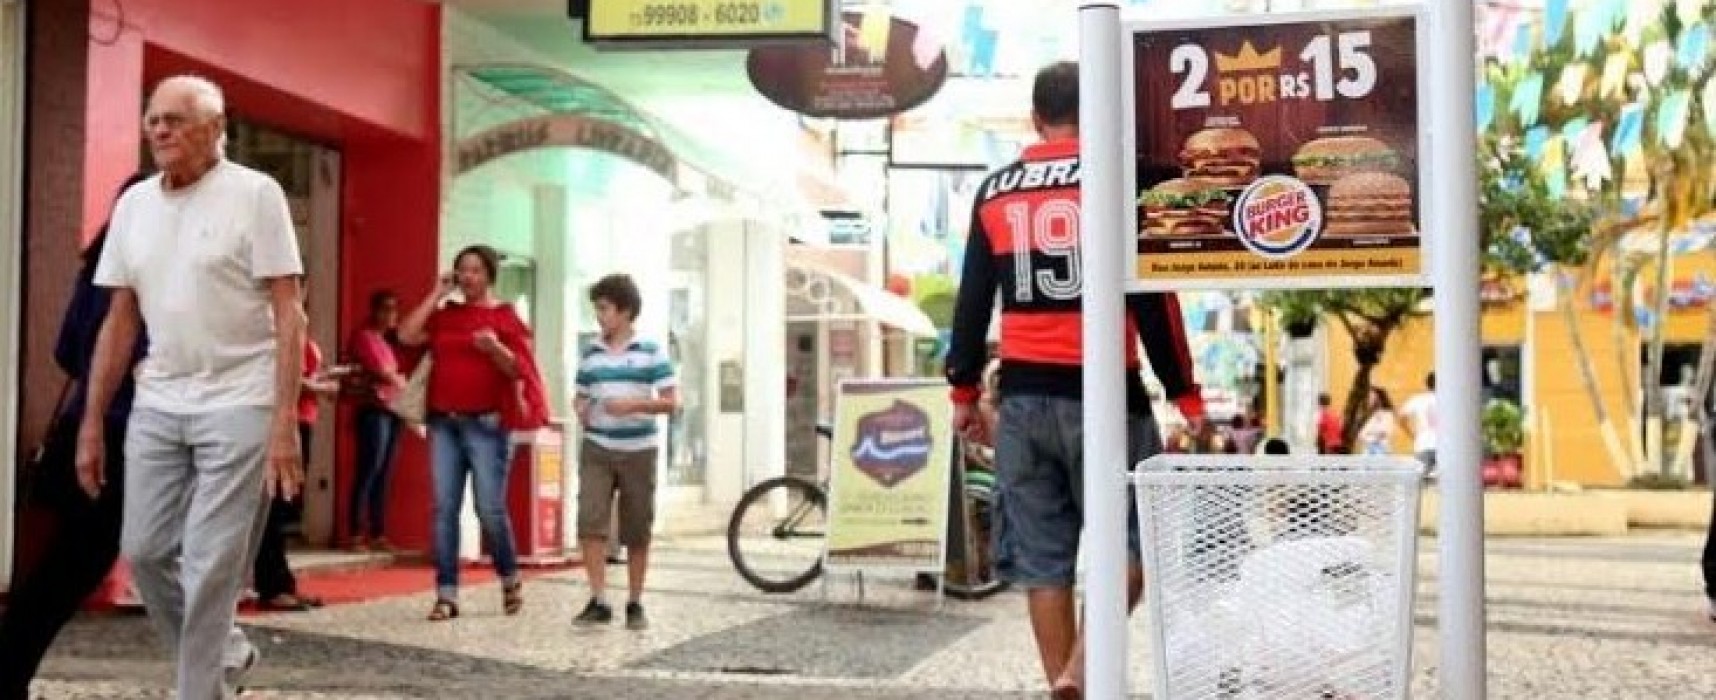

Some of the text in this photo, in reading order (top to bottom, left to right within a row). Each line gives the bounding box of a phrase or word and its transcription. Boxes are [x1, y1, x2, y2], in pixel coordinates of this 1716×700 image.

[1169, 43, 1211, 110] 2
[1219, 74, 1277, 107] POR
[1246, 191, 1306, 219] BURGER
[1248, 206, 1310, 240] KING
[1005, 198, 1082, 302] 19
